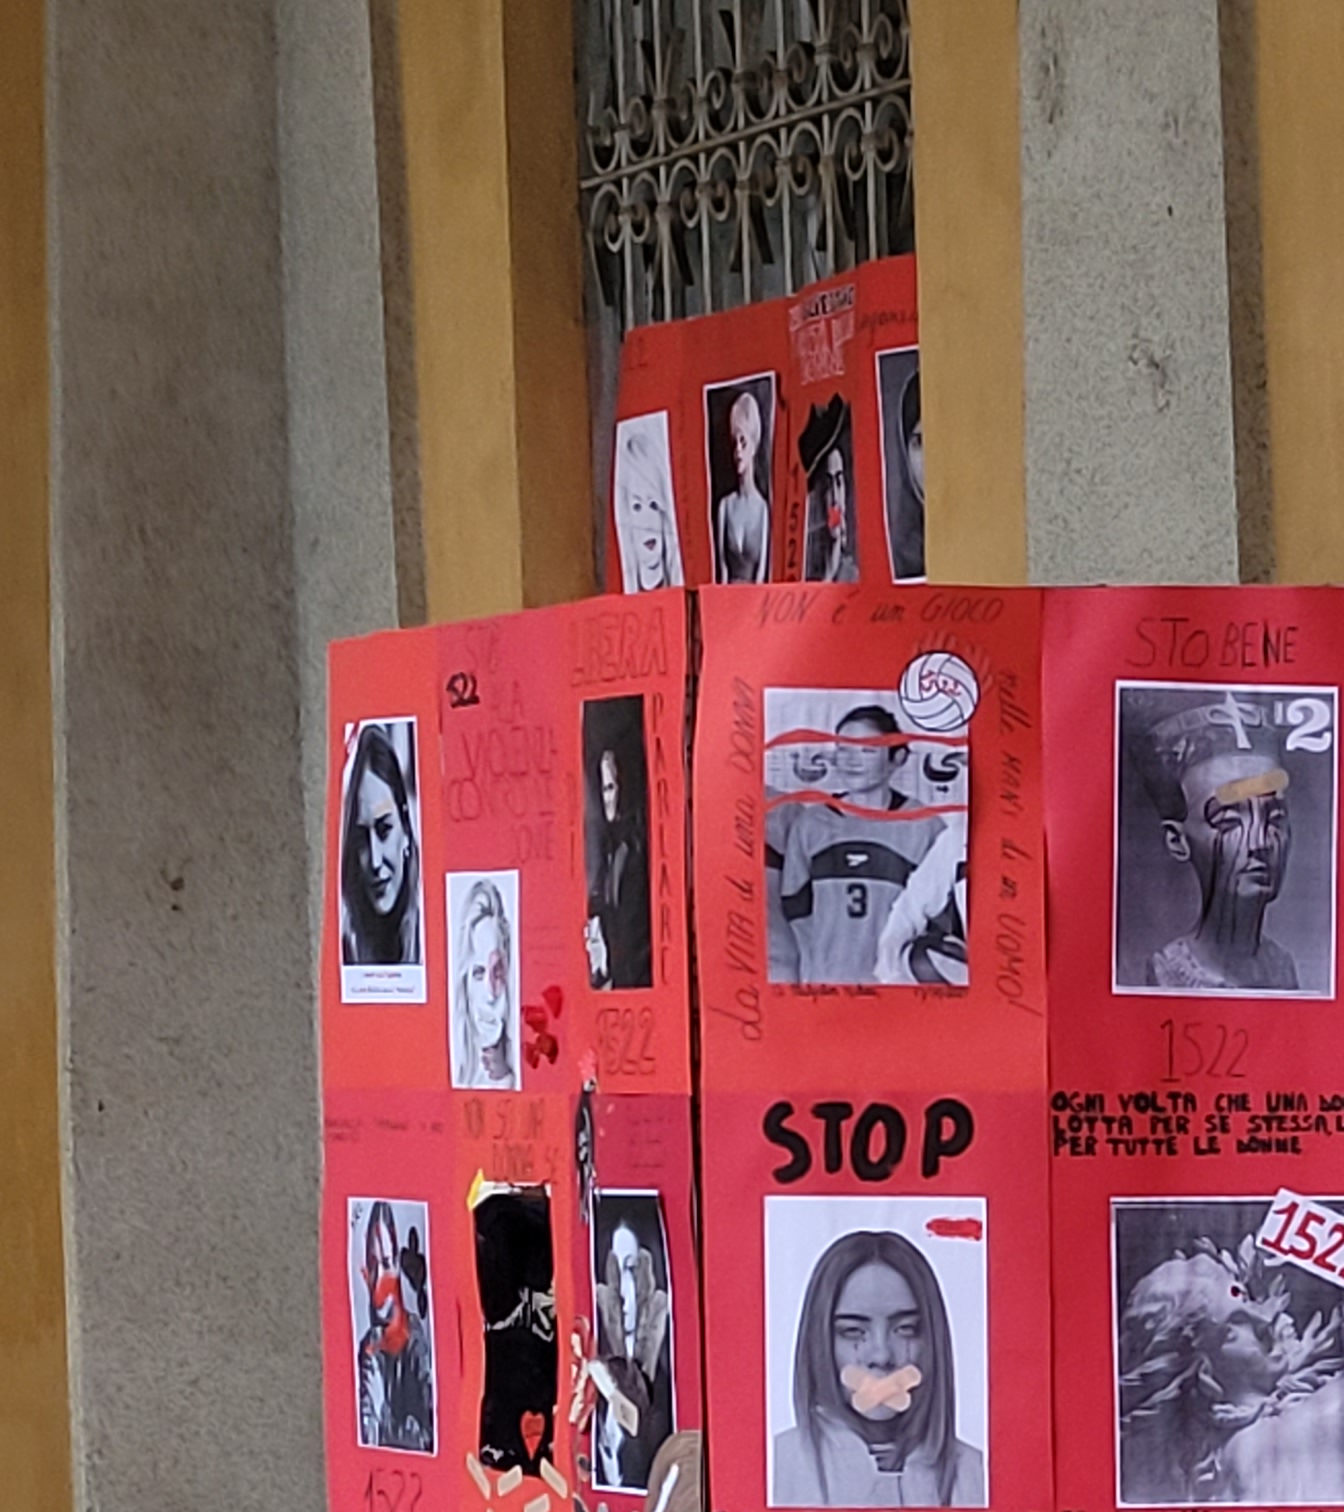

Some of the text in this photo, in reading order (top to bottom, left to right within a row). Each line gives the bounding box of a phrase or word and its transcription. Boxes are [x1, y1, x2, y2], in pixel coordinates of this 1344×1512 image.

[758, 590, 820, 628] NON
[1127, 616, 1300, 671] STO BENE
[846, 883, 869, 919] 3
[725, 910, 758, 974] VITA
[1159, 1018, 1251, 1083] 1522
[1050, 1091, 1105, 1113] OGNI
[1118, 1091, 1197, 1113] VOLTA
[1214, 1091, 1252, 1112] CHE
[1266, 1091, 1308, 1112] UNA
[762, 1097, 975, 1185] STOP
[1053, 1115, 1133, 1136] LOTTA
[1151, 1115, 1190, 1135] PER
[1205, 1115, 1231, 1134] SE
[1053, 1134, 1303, 1157] PER TUTTE LE DONNE
